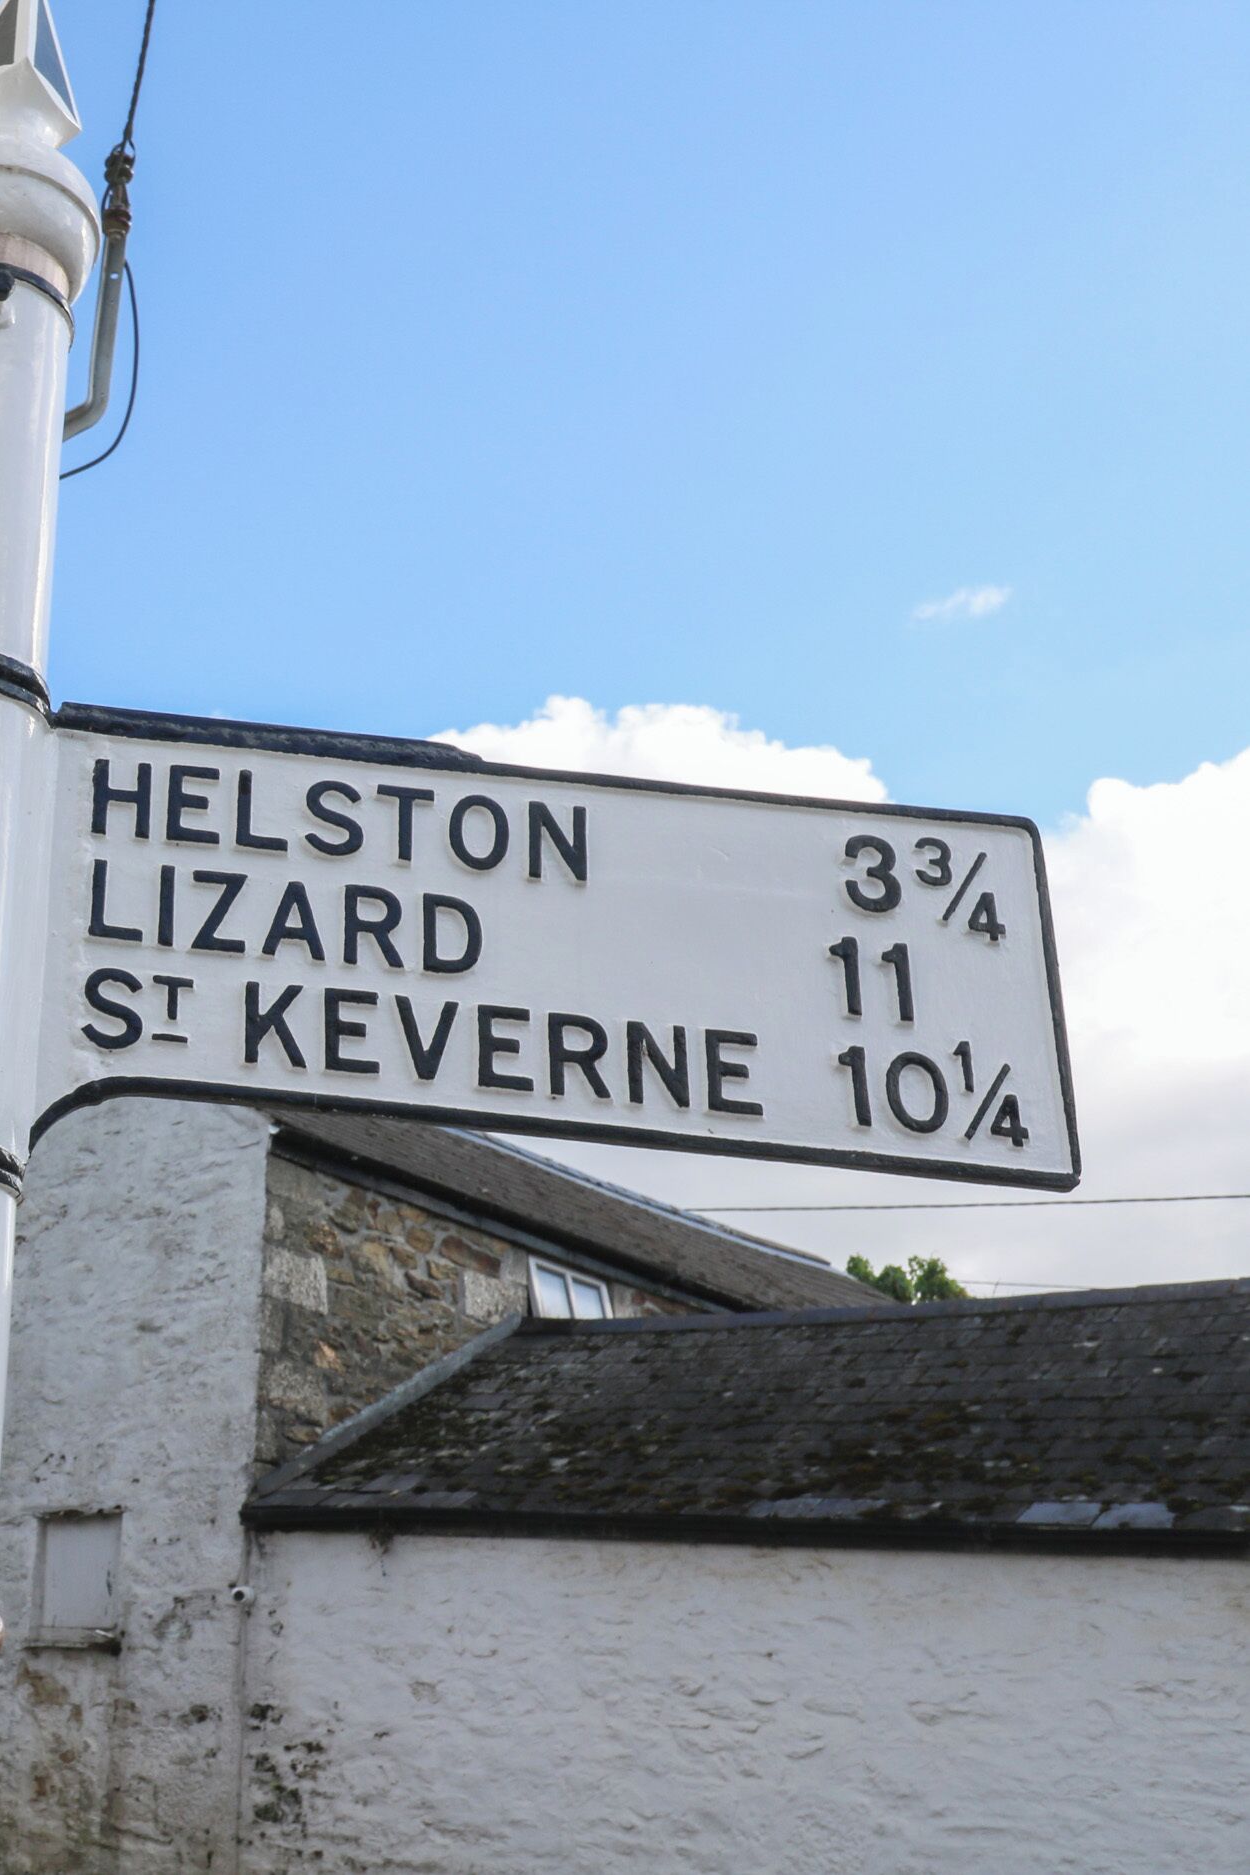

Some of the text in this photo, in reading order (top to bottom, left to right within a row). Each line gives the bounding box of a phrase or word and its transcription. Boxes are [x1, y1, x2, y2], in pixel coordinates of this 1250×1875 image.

[90, 758, 588, 882] HELSTON
[87, 858, 915, 1022] LIZARD 11
[244, 981, 764, 1117] KEVERNE
